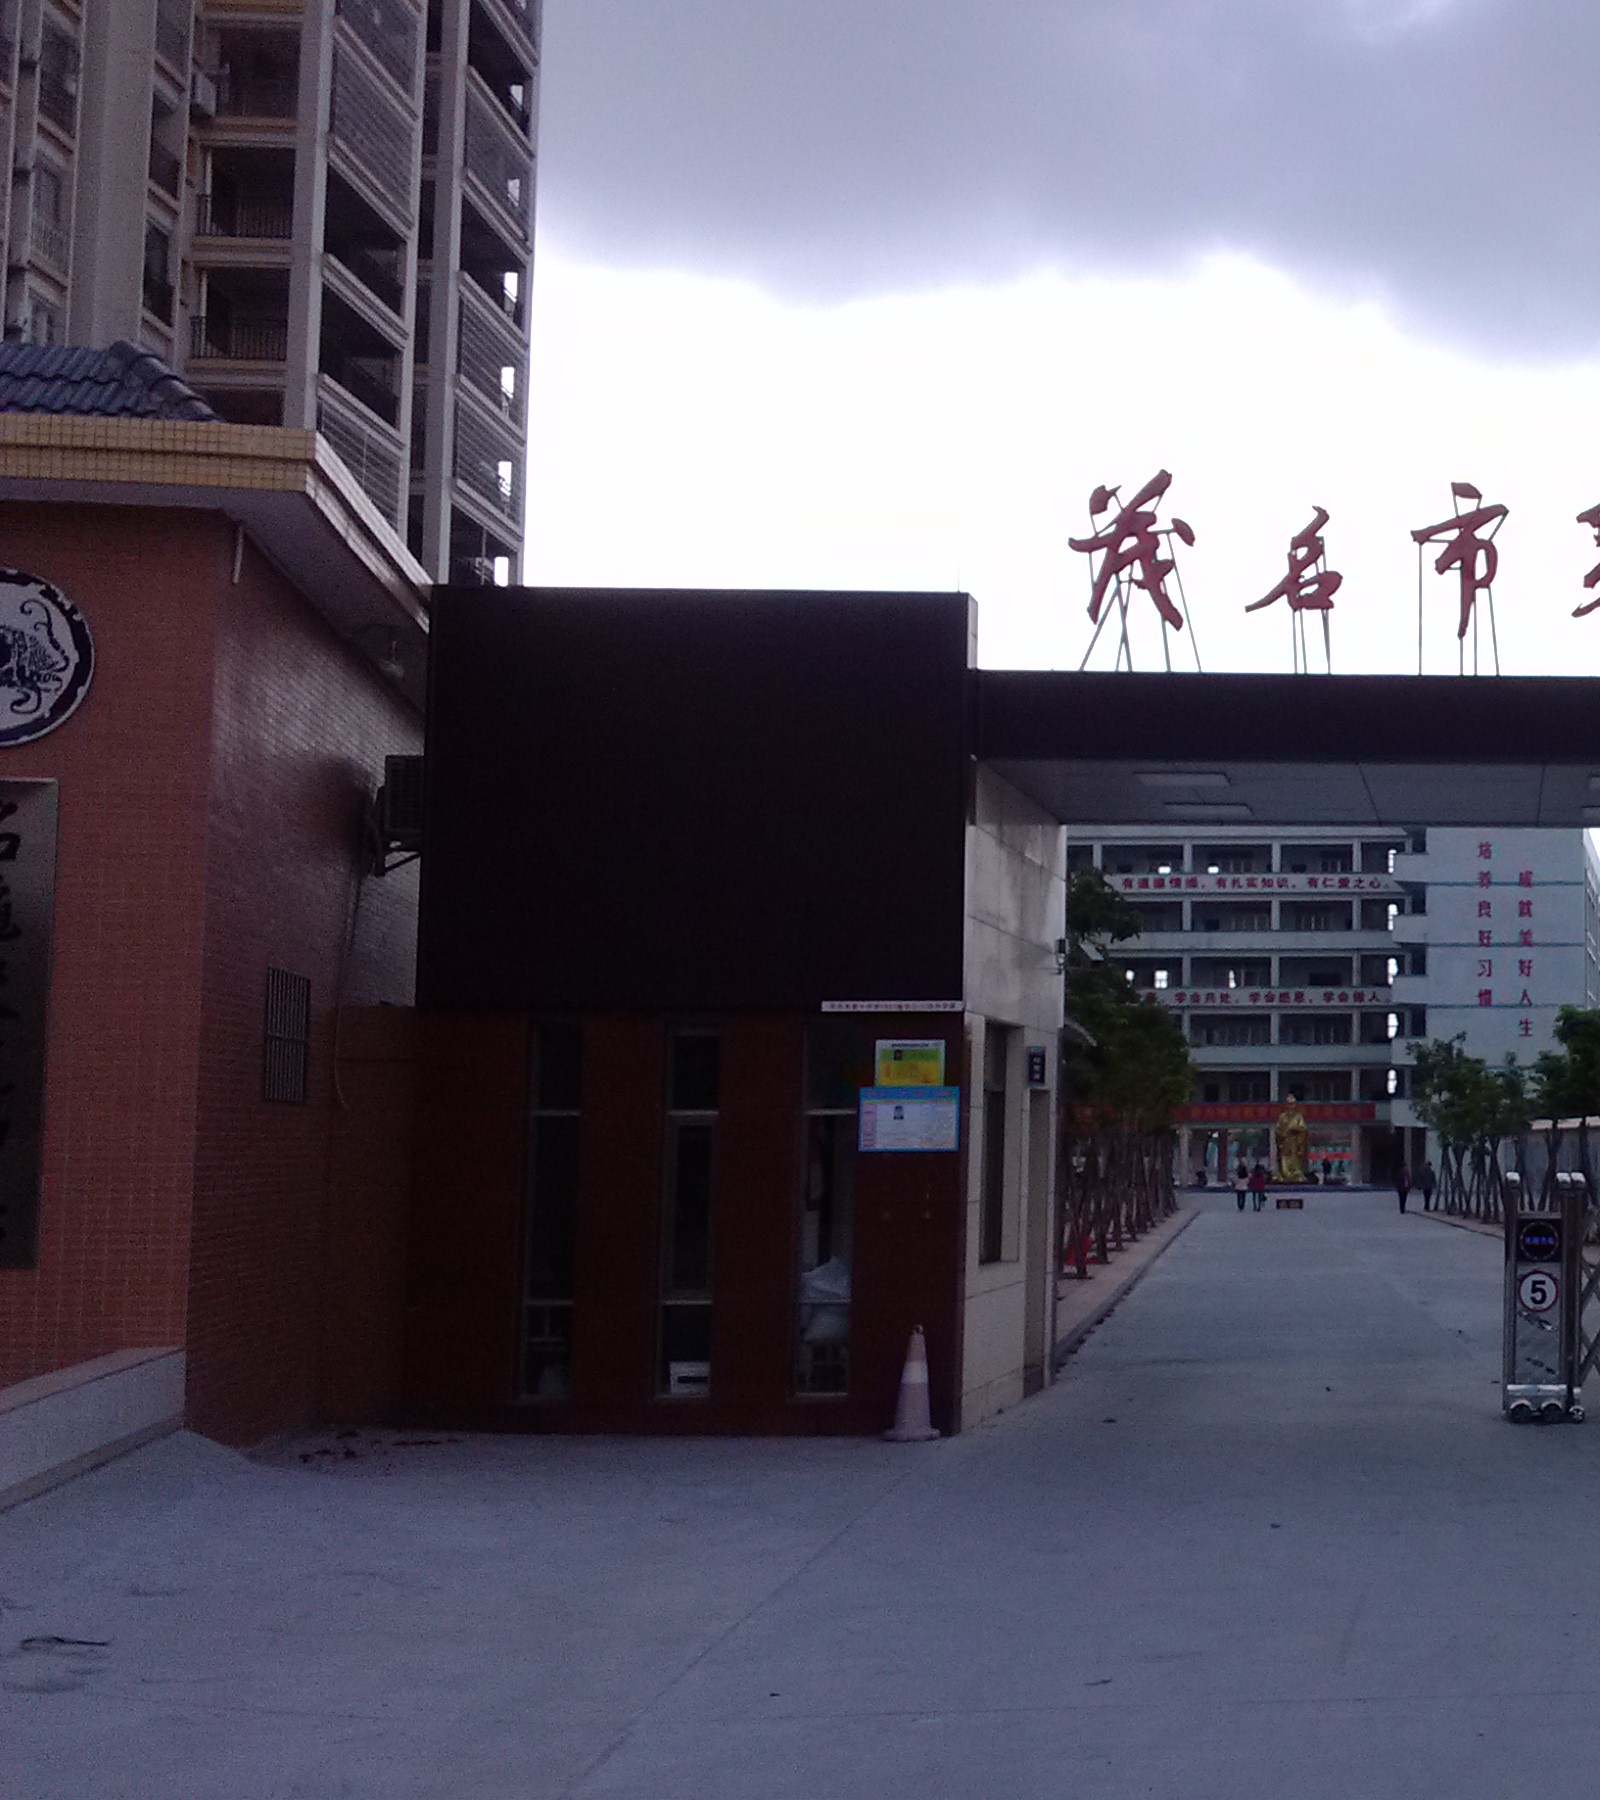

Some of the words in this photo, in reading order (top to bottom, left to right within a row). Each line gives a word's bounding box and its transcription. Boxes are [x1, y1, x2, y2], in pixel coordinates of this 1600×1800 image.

[1476, 840, 1493, 1008] 培养良好习惯
[1518, 870, 1534, 1038] 成就美好人生
[1530, 1280, 1547, 1305] 5
